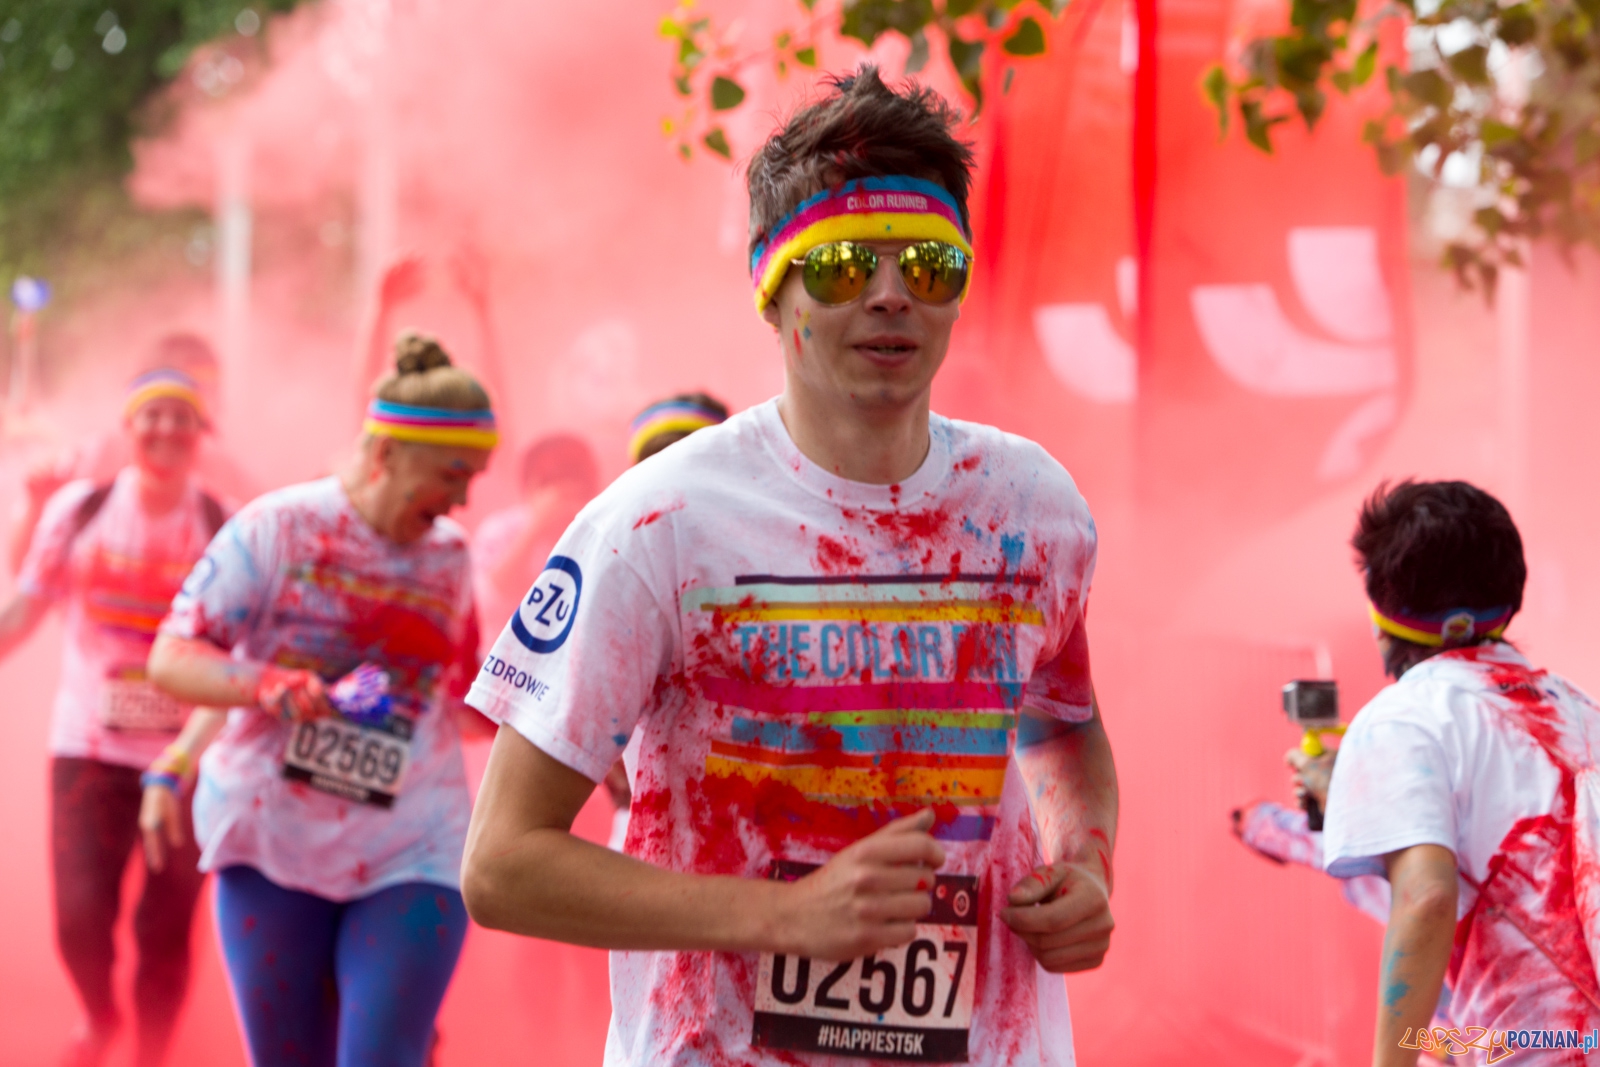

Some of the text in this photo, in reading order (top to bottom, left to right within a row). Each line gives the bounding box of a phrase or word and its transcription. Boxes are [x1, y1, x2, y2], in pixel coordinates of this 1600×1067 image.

[846, 193, 928, 211] COLOR RUNNER
[526, 583, 570, 627] PZU
[733, 623, 810, 679] THE
[820, 624, 944, 679] COLOR
[483, 655, 550, 702] ZDROWIE
[294, 721, 402, 786] 02569
[771, 938, 969, 1019] 02567
[817, 1024, 925, 1056] #HAPPIEST5K
